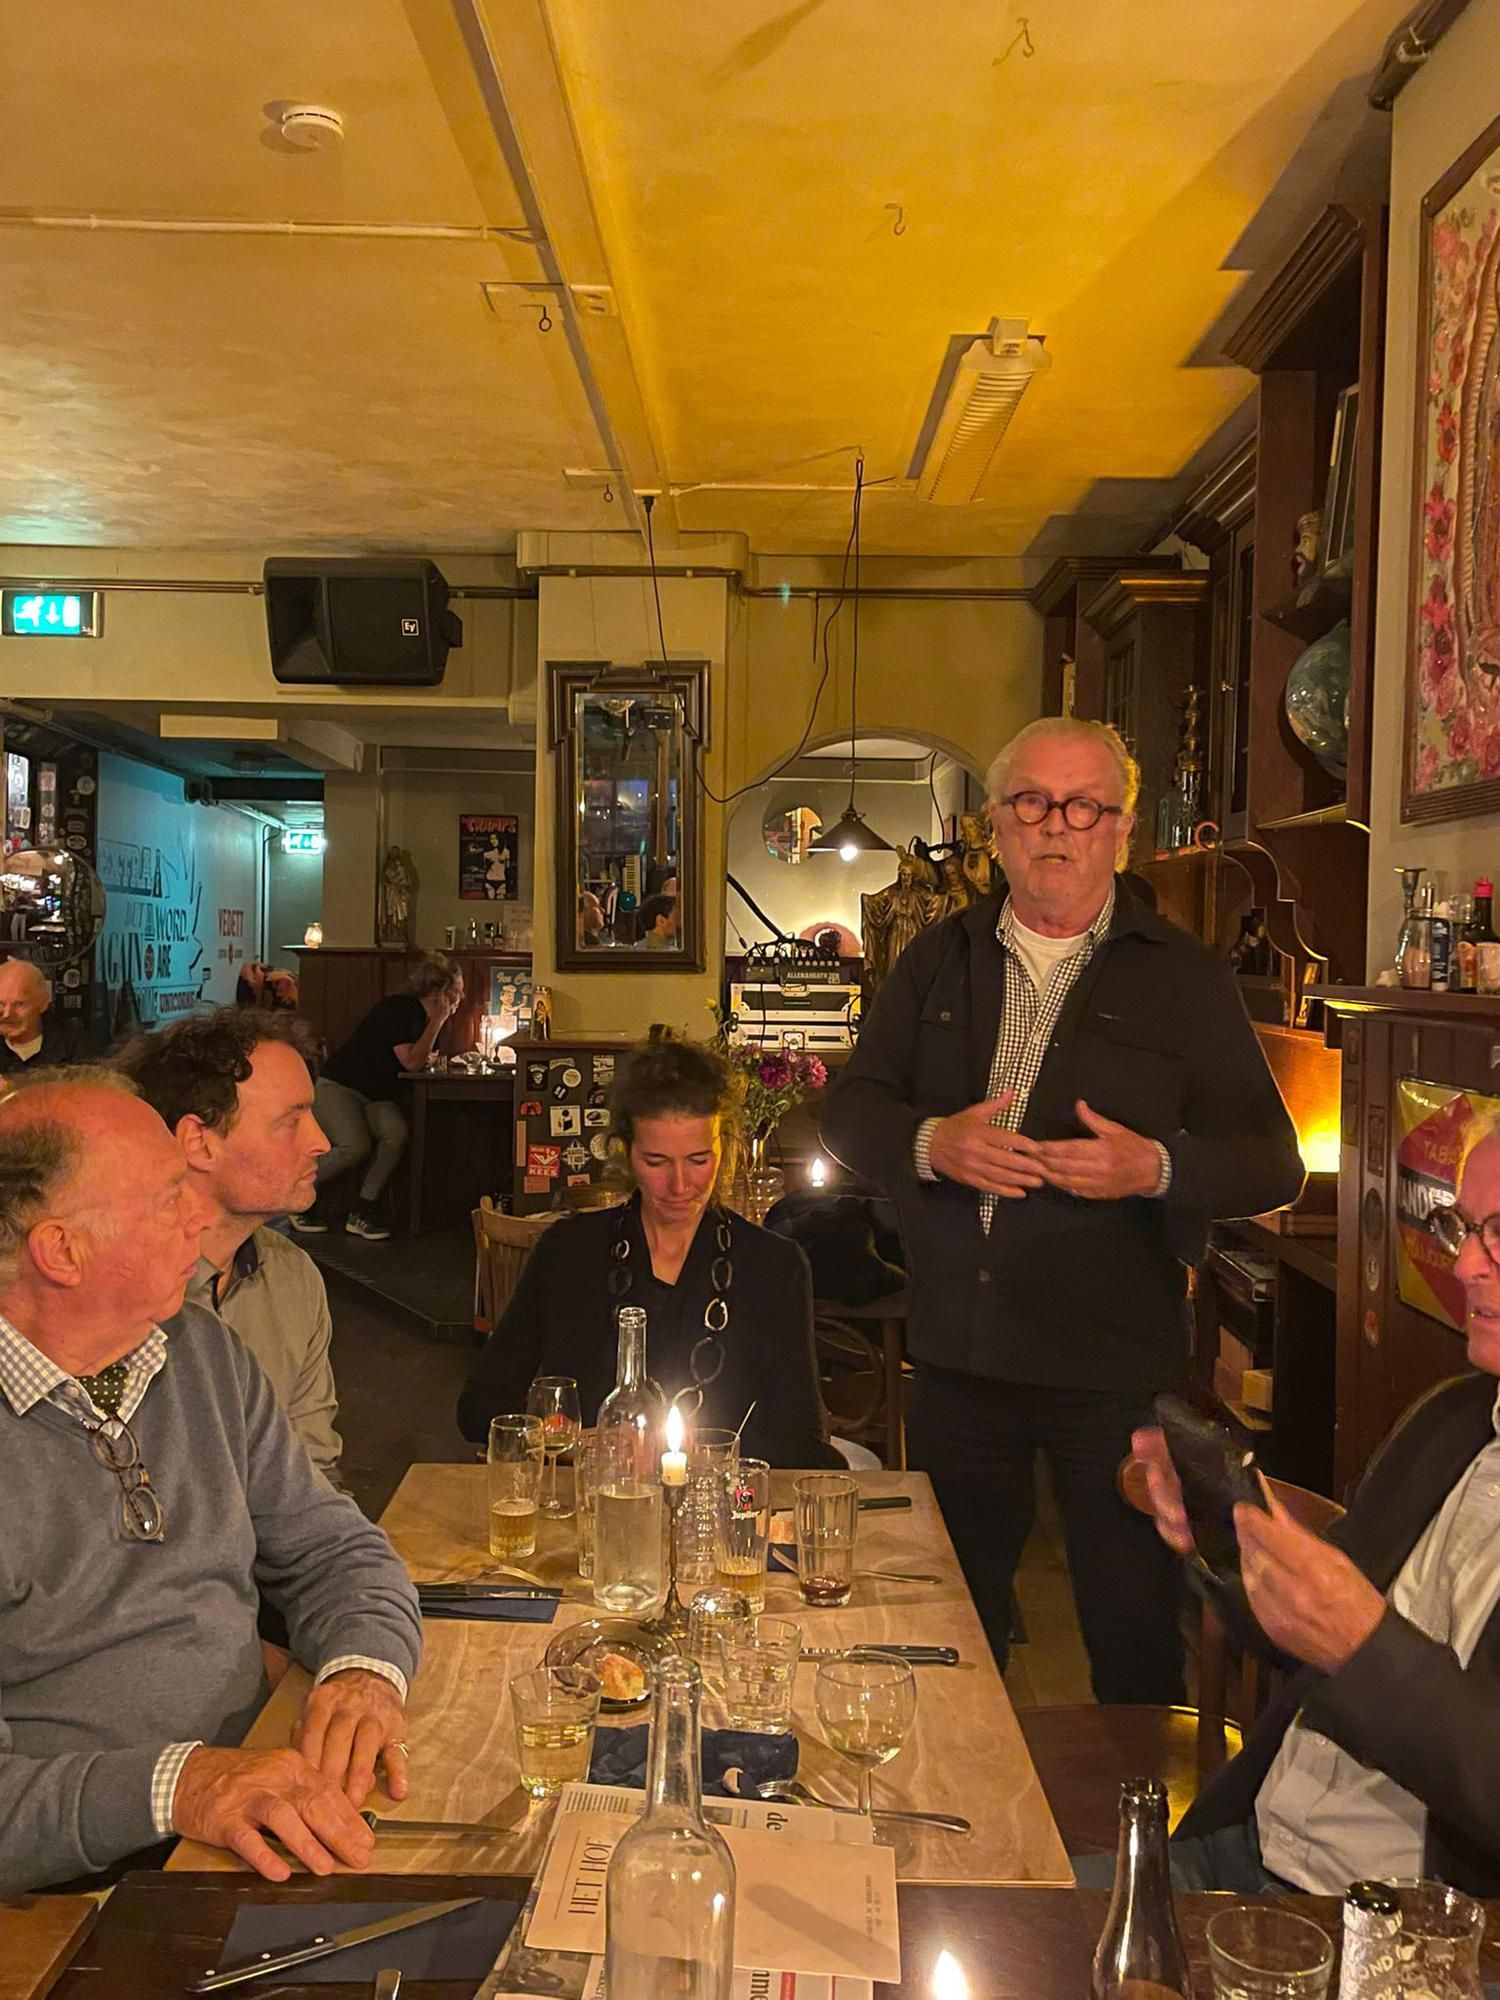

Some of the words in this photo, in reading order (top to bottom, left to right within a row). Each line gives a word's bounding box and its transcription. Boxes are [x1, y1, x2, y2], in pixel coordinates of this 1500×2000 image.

[530, 1168, 557, 1177] KEES
[767, 1811, 788, 1831] de
[579, 1836, 613, 1872] HOF
[568, 1878, 602, 1914] HET
